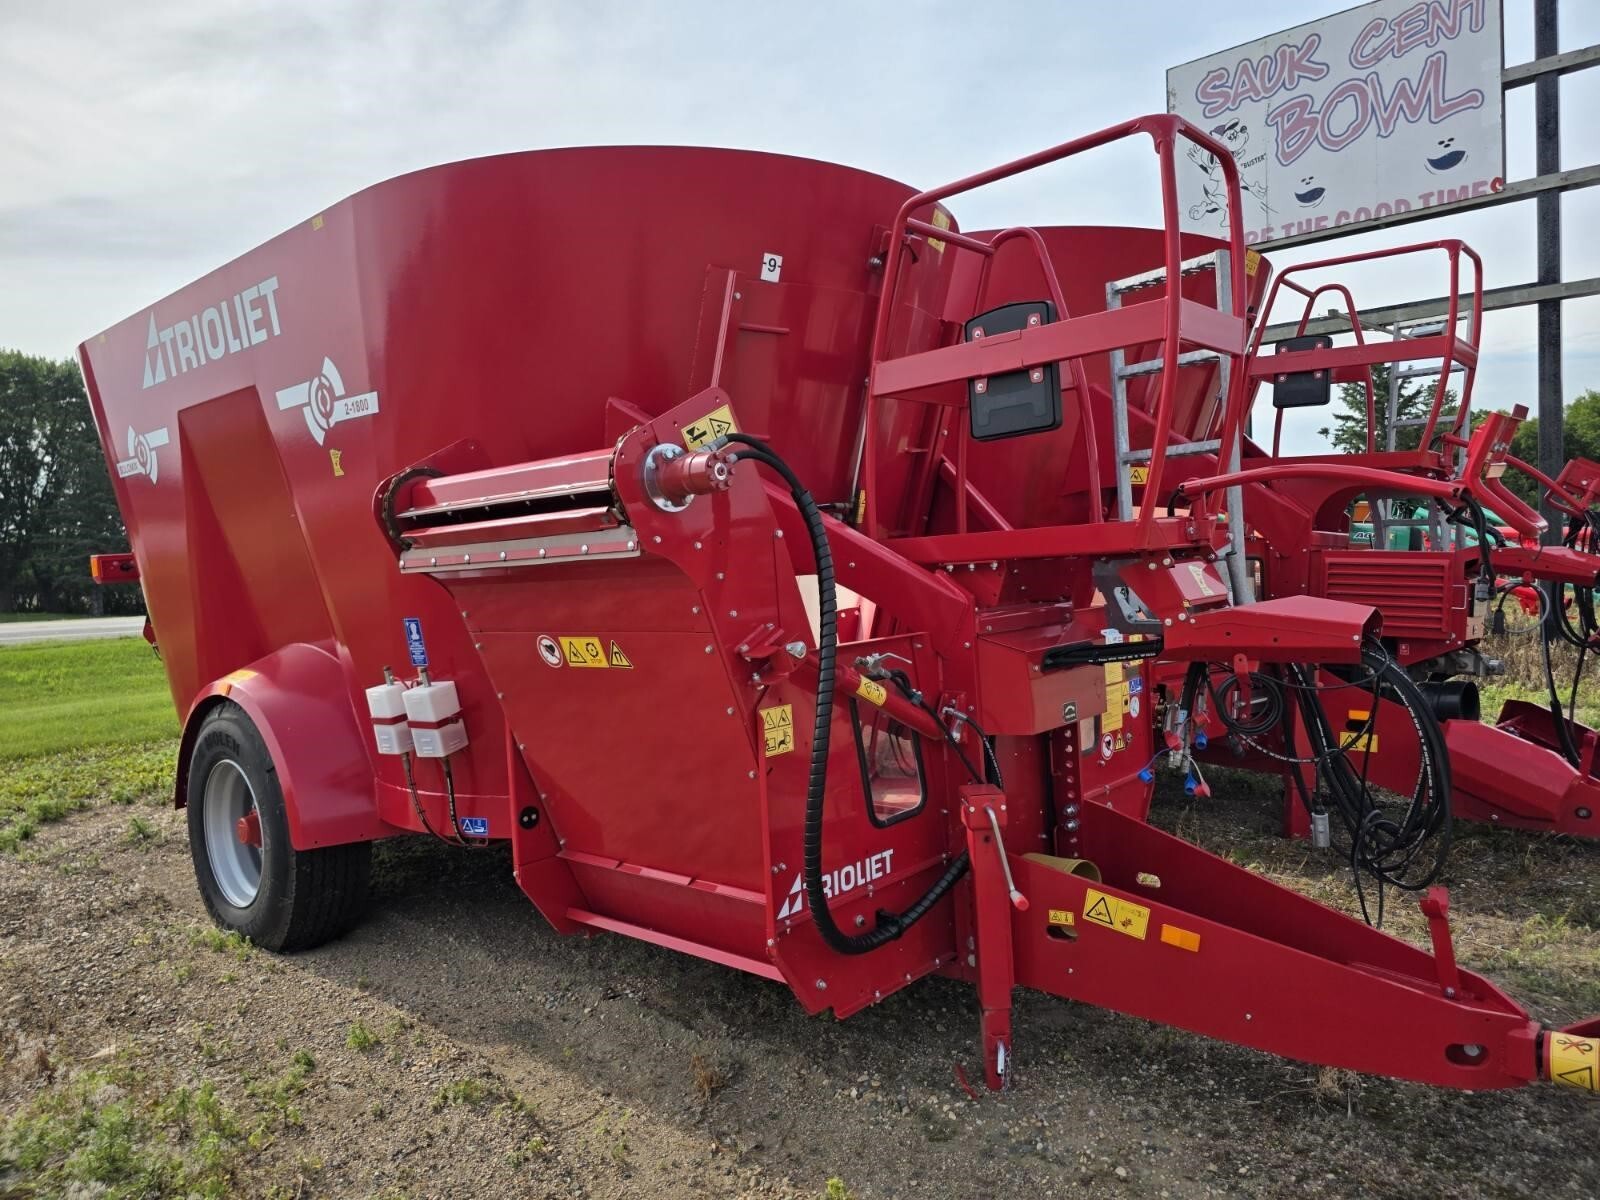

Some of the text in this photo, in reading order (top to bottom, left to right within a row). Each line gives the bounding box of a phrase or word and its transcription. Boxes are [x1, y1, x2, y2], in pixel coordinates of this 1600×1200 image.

[1196, 33, 1330, 119] SAUK
[1267, 50, 1485, 168] BOWL
[157, 275, 281, 378] TRIOLIET
[802, 848, 894, 899] RIOLIET
